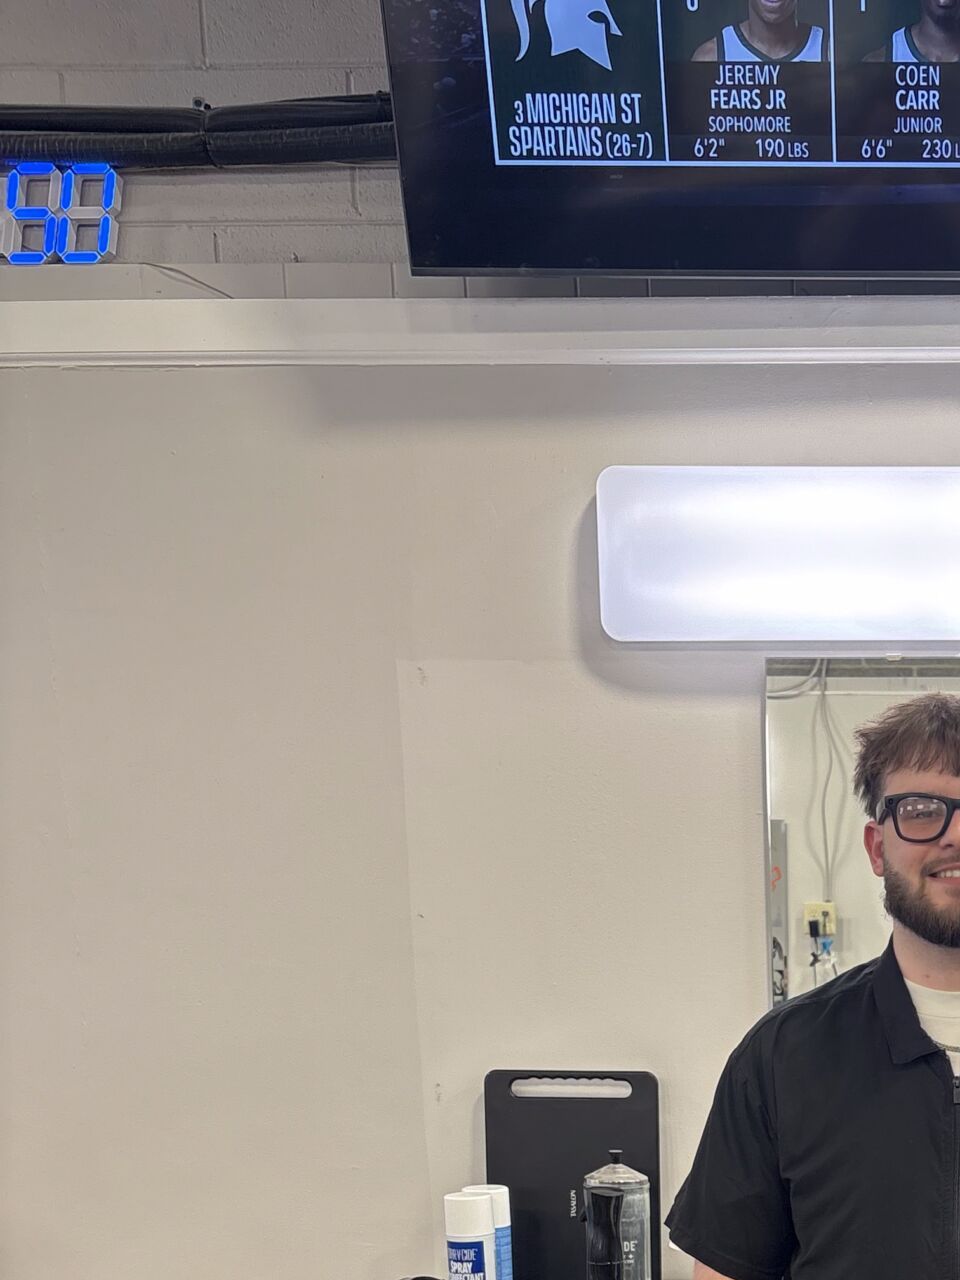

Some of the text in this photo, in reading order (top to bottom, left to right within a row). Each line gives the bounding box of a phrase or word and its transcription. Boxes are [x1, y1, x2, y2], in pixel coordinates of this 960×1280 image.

[715, 64, 781, 85] JEREMY
[895, 64, 940, 86] COEN
[514, 92, 642, 124] 3 MICHIGAN ST
[710, 88, 787, 110] FEARS JR
[895, 89, 940, 111] CARR
[708, 115, 792, 133] SOPHOMORE
[893, 116, 943, 134] JUNIOR
[508, 125, 653, 159] SPARTANS (26-7)
[694, 137, 809, 158] 6'2" 190 LBS
[861, 139, 893, 159] 6'6"
[922, 139, 952, 159] 230
[6, 162, 117, 264] 50
[450, 1261, 473, 1274] SPRAY
